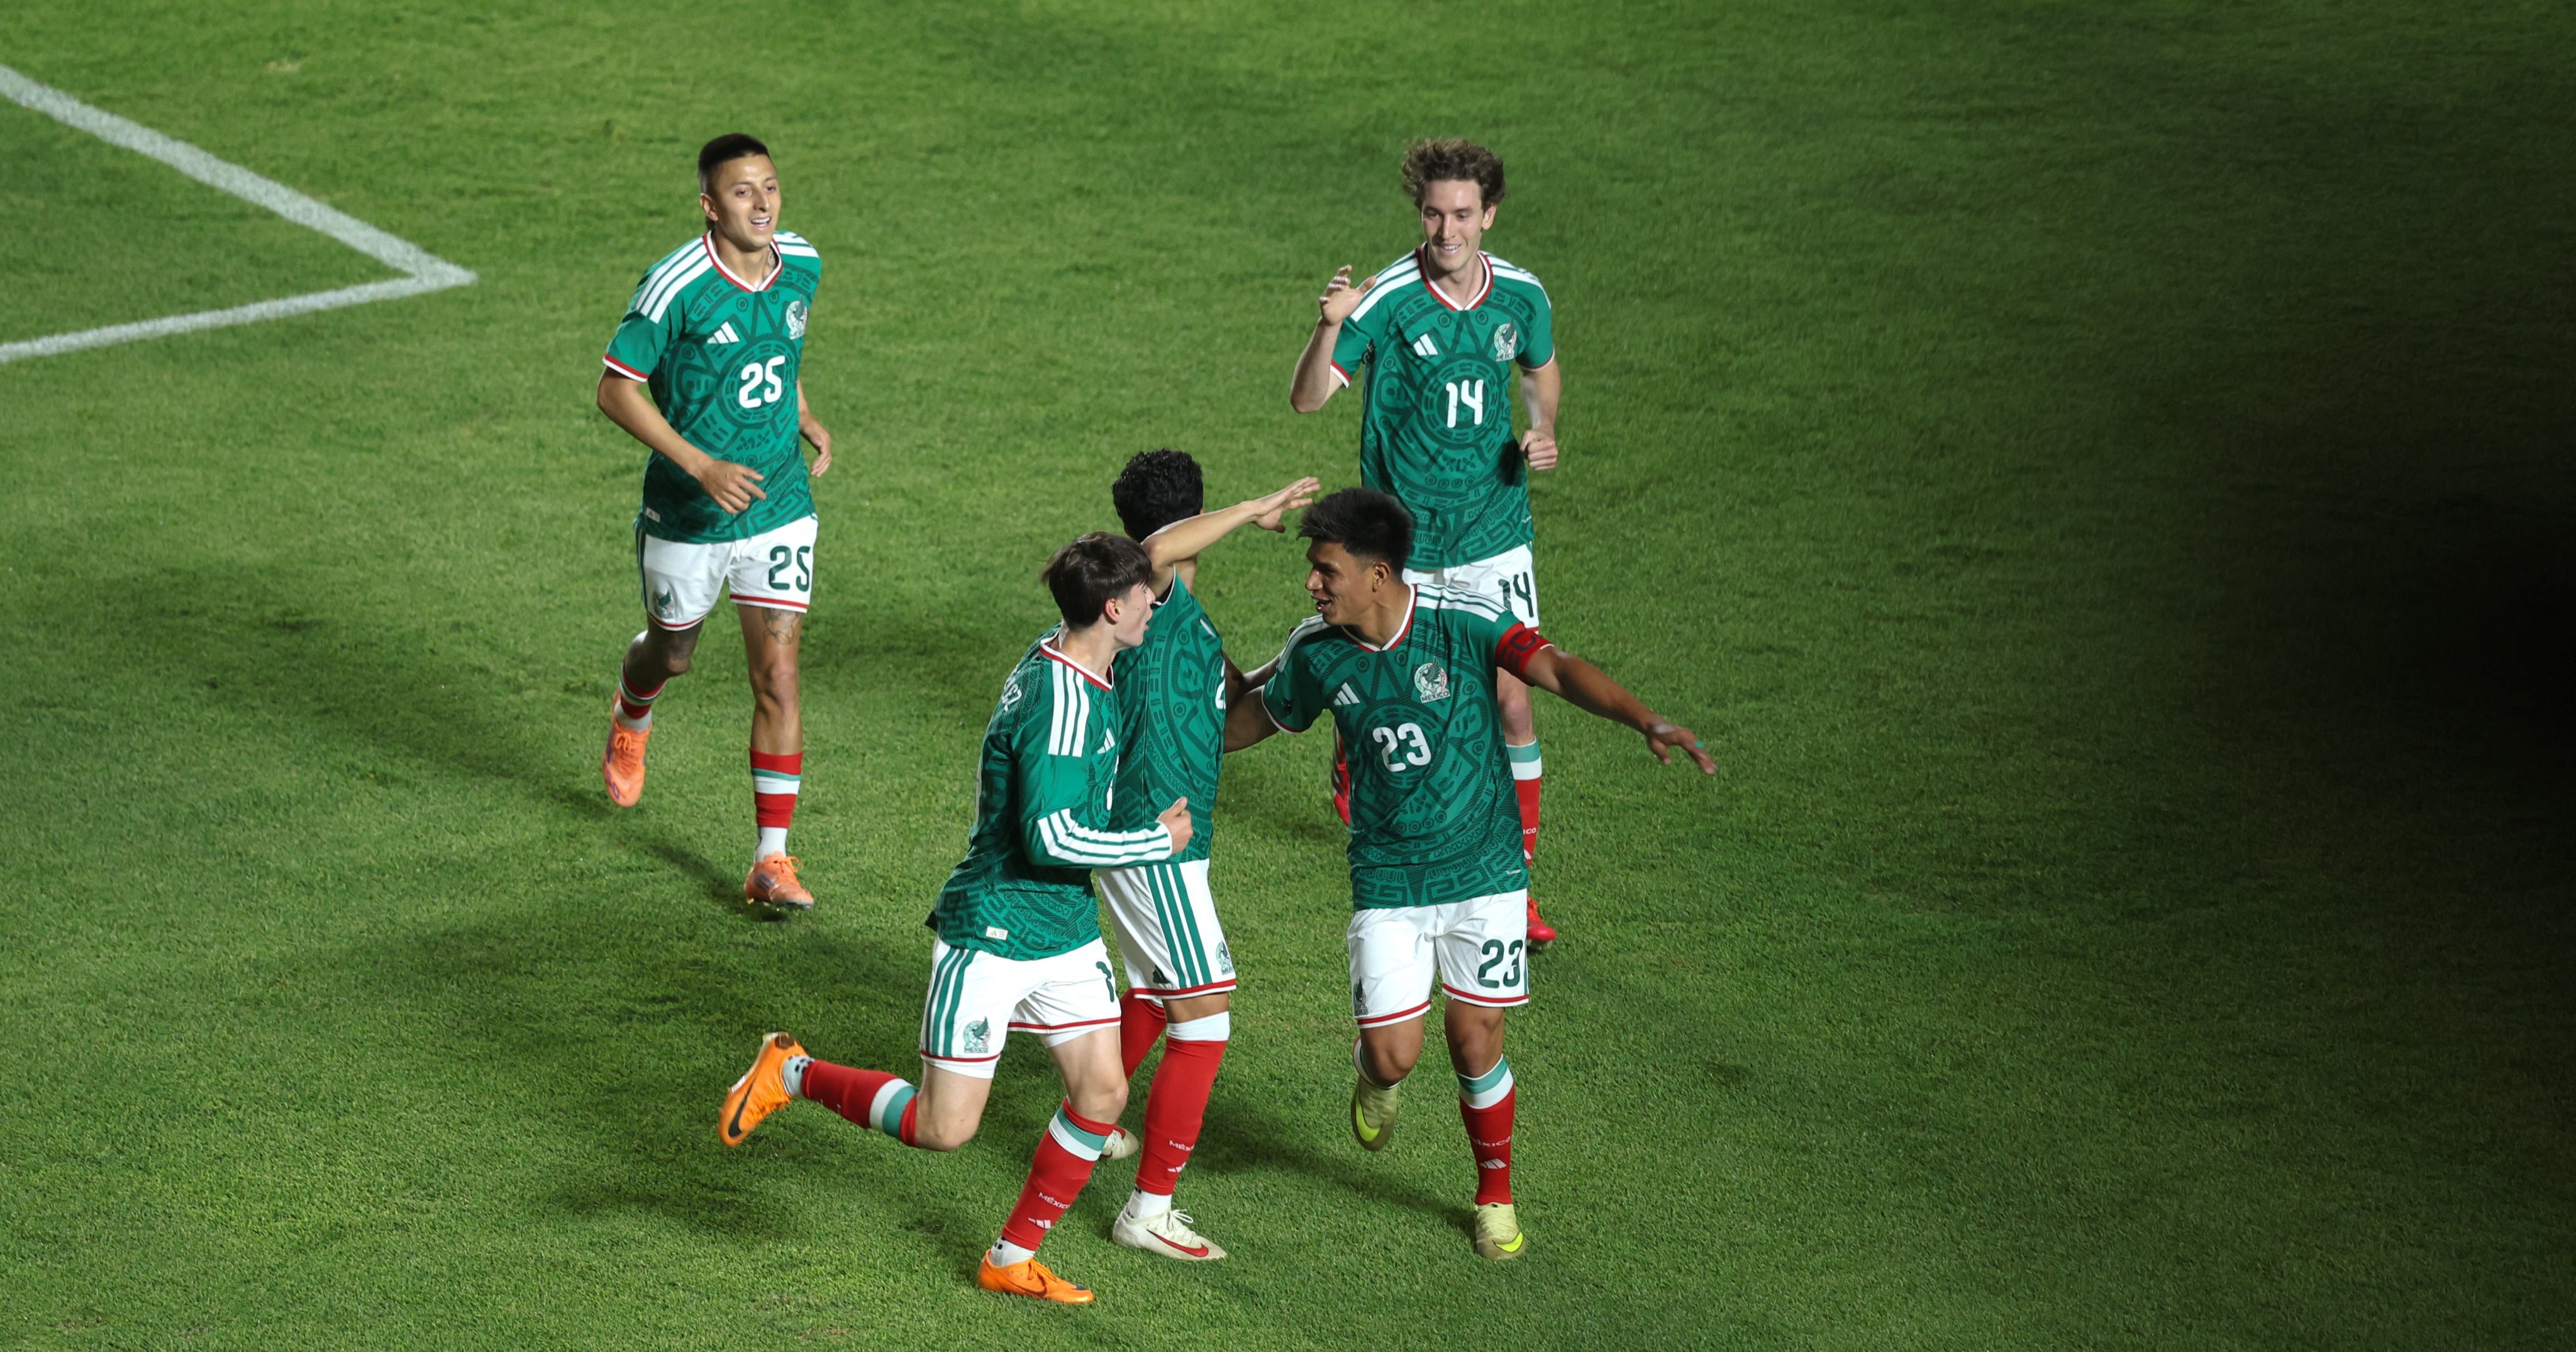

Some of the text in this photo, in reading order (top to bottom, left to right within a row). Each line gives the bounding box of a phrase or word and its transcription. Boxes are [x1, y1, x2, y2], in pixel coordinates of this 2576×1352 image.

[739, 355, 786, 408] 25
[1446, 379, 1484, 428] 14
[769, 546, 810, 592] 25
[1498, 572, 1534, 618] 14
[1421, 691, 1449, 702] MÉXICO
[1373, 723, 1431, 772] 23
[1477, 939, 1523, 989] 23
